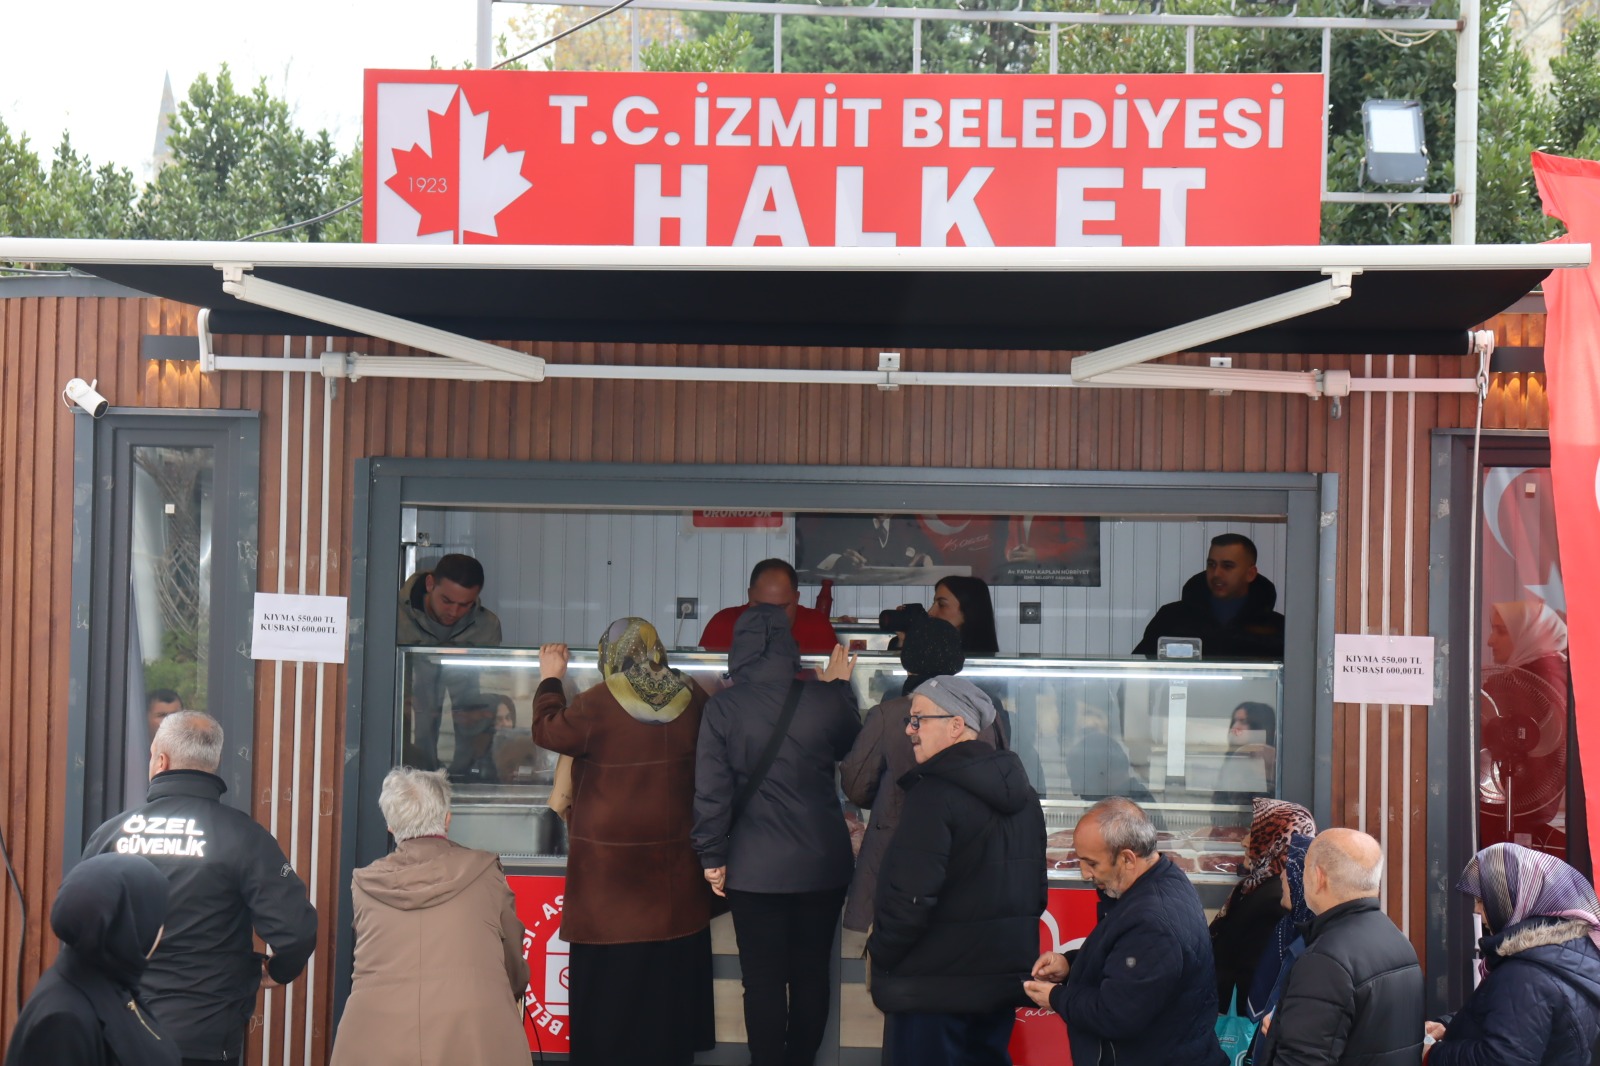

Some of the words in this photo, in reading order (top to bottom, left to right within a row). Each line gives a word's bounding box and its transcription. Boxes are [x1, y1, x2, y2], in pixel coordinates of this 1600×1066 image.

[549, 95, 681, 146] T.C.
[694, 82, 882, 148] İZMİT
[902, 82, 1285, 149] BELEDİYESİ
[408, 176, 448, 193] 1923
[633, 163, 996, 247] HALK
[1055, 167, 1206, 247] ET
[264, 613, 295, 622] KIYMA
[297, 614, 322, 623] 550,00
[324, 616, 336, 624] TL
[260, 623, 300, 633] KUŞBAŞI
[301, 625, 338, 634] 600,00TL
[1346, 655, 1379, 663] KIYMA
[1381, 656, 1408, 664] 550,00
[1409, 657, 1423, 665] TL
[1342, 665, 1384, 675] KUŞBAŞI
[1385, 666, 1425, 675] 600,00TL
[123, 815, 204, 836] ÖZEL
[116, 835, 207, 857] GÜVENLİK
